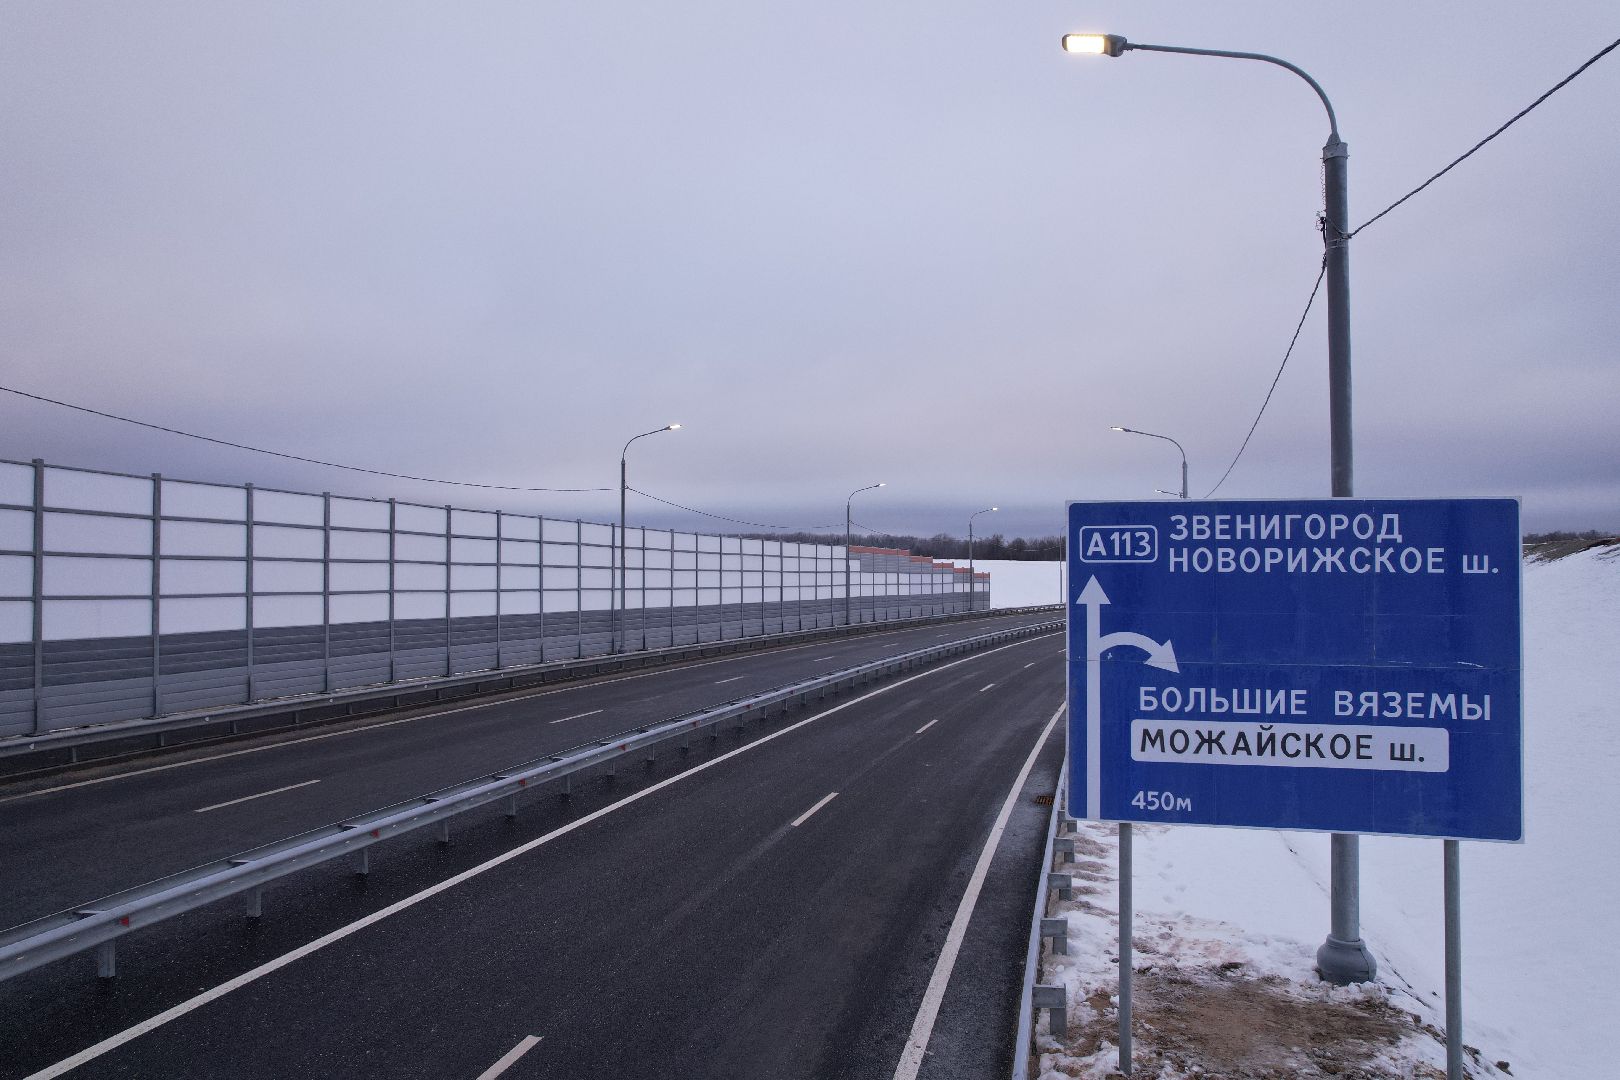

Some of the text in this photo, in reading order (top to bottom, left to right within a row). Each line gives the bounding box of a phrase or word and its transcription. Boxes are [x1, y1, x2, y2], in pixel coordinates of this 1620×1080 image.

[1169, 513, 1403, 544] ЗВЕНИГОРОД
[1169, 546, 1499, 574] НОВОРИЖСКОЕ ш.
[1139, 686, 1491, 721] БОЛЬШИЕ ВЯЗЕМЫ
[1139, 724, 1425, 763] МОЖАЙСКОЕ ш.
[1131, 790, 1192, 812] 450м
